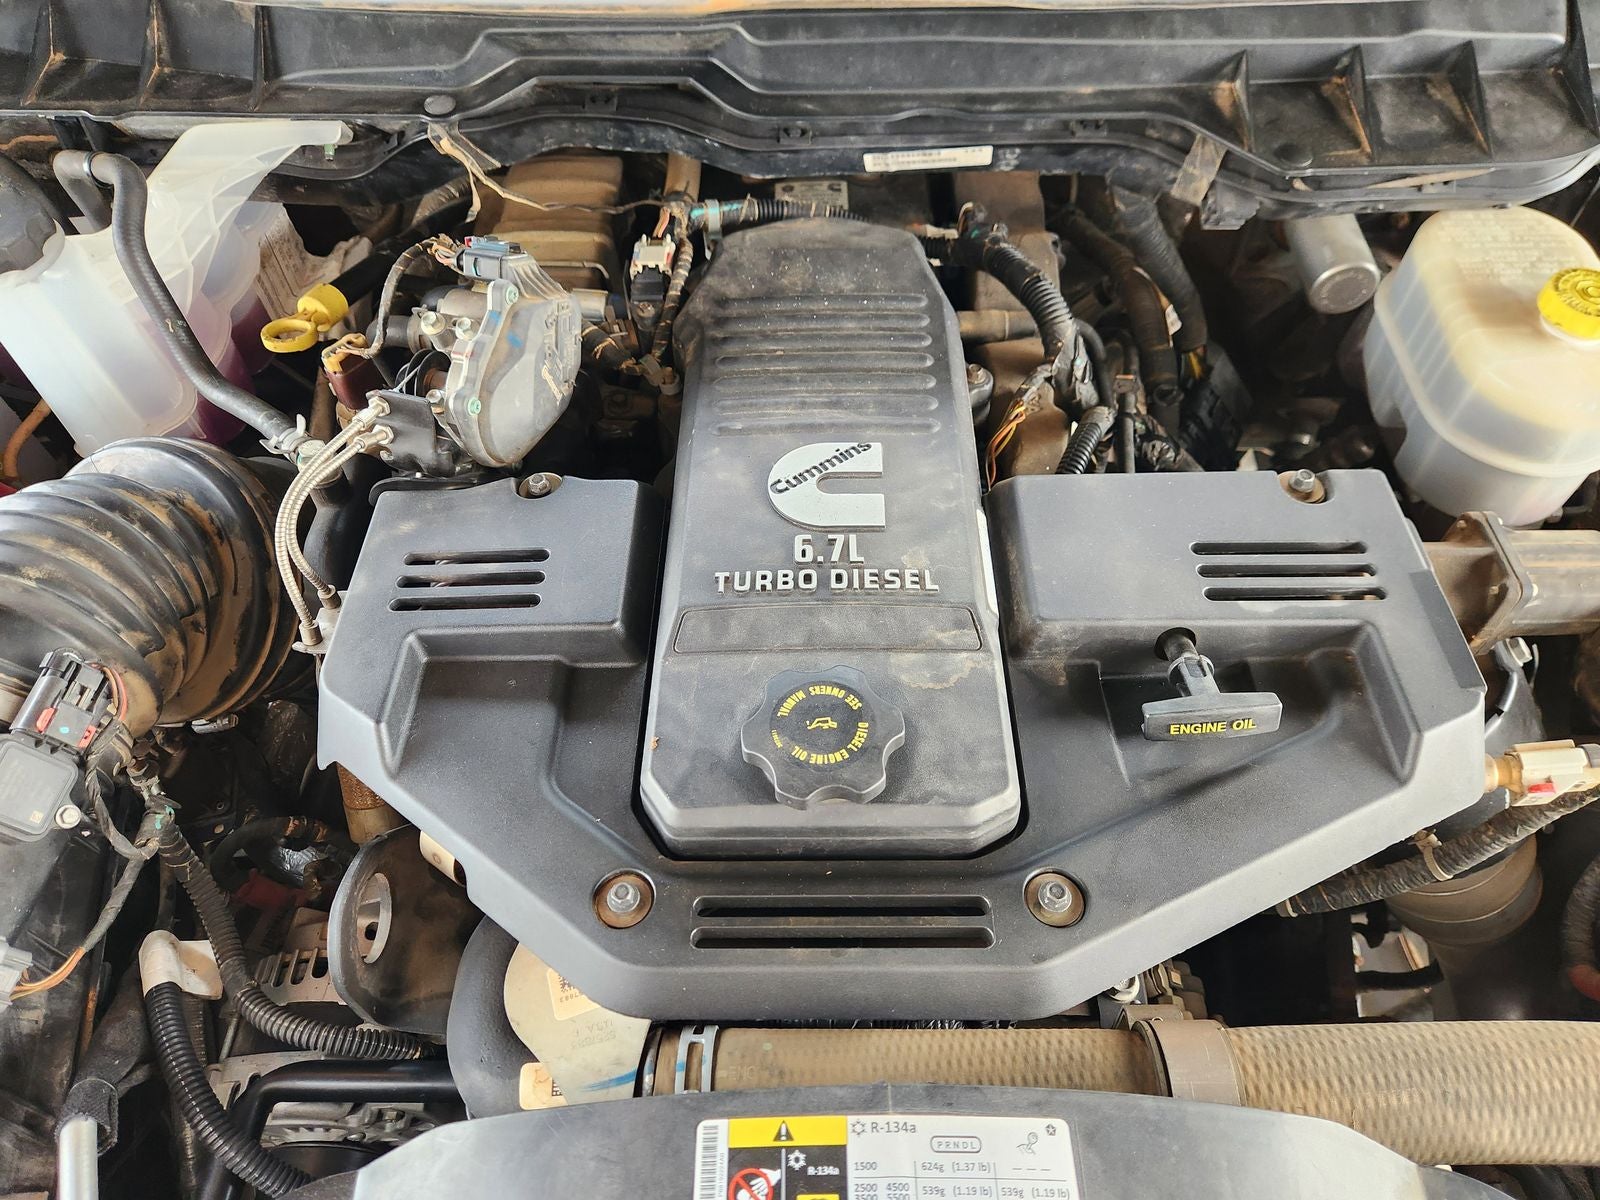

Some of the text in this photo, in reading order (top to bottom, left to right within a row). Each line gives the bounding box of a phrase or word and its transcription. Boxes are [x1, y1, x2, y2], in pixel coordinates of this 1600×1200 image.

[769, 442, 873, 494] Cummins
[794, 534, 865, 564] 6.7L
[714, 568, 940, 593] TURBO DIESEL
[777, 685, 863, 717] SEE OWNERS MANUAL
[1169, 718, 1257, 735] ENGINE OIL
[791, 722, 869, 764] DIESEL ENGINE OIL
[870, 1121, 917, 1134] R-134a
[807, 1165, 840, 1176] R-134a
[854, 1161, 878, 1171] 1500
[921, 1161, 991, 1174] 624g (1.37 lb)
[854, 1182, 910, 1193] 2500 4500
[922, 1185, 993, 1197] 539g (1.19 lb)
[1001, 1187, 1070, 1200] 539g (1.19 lb)
